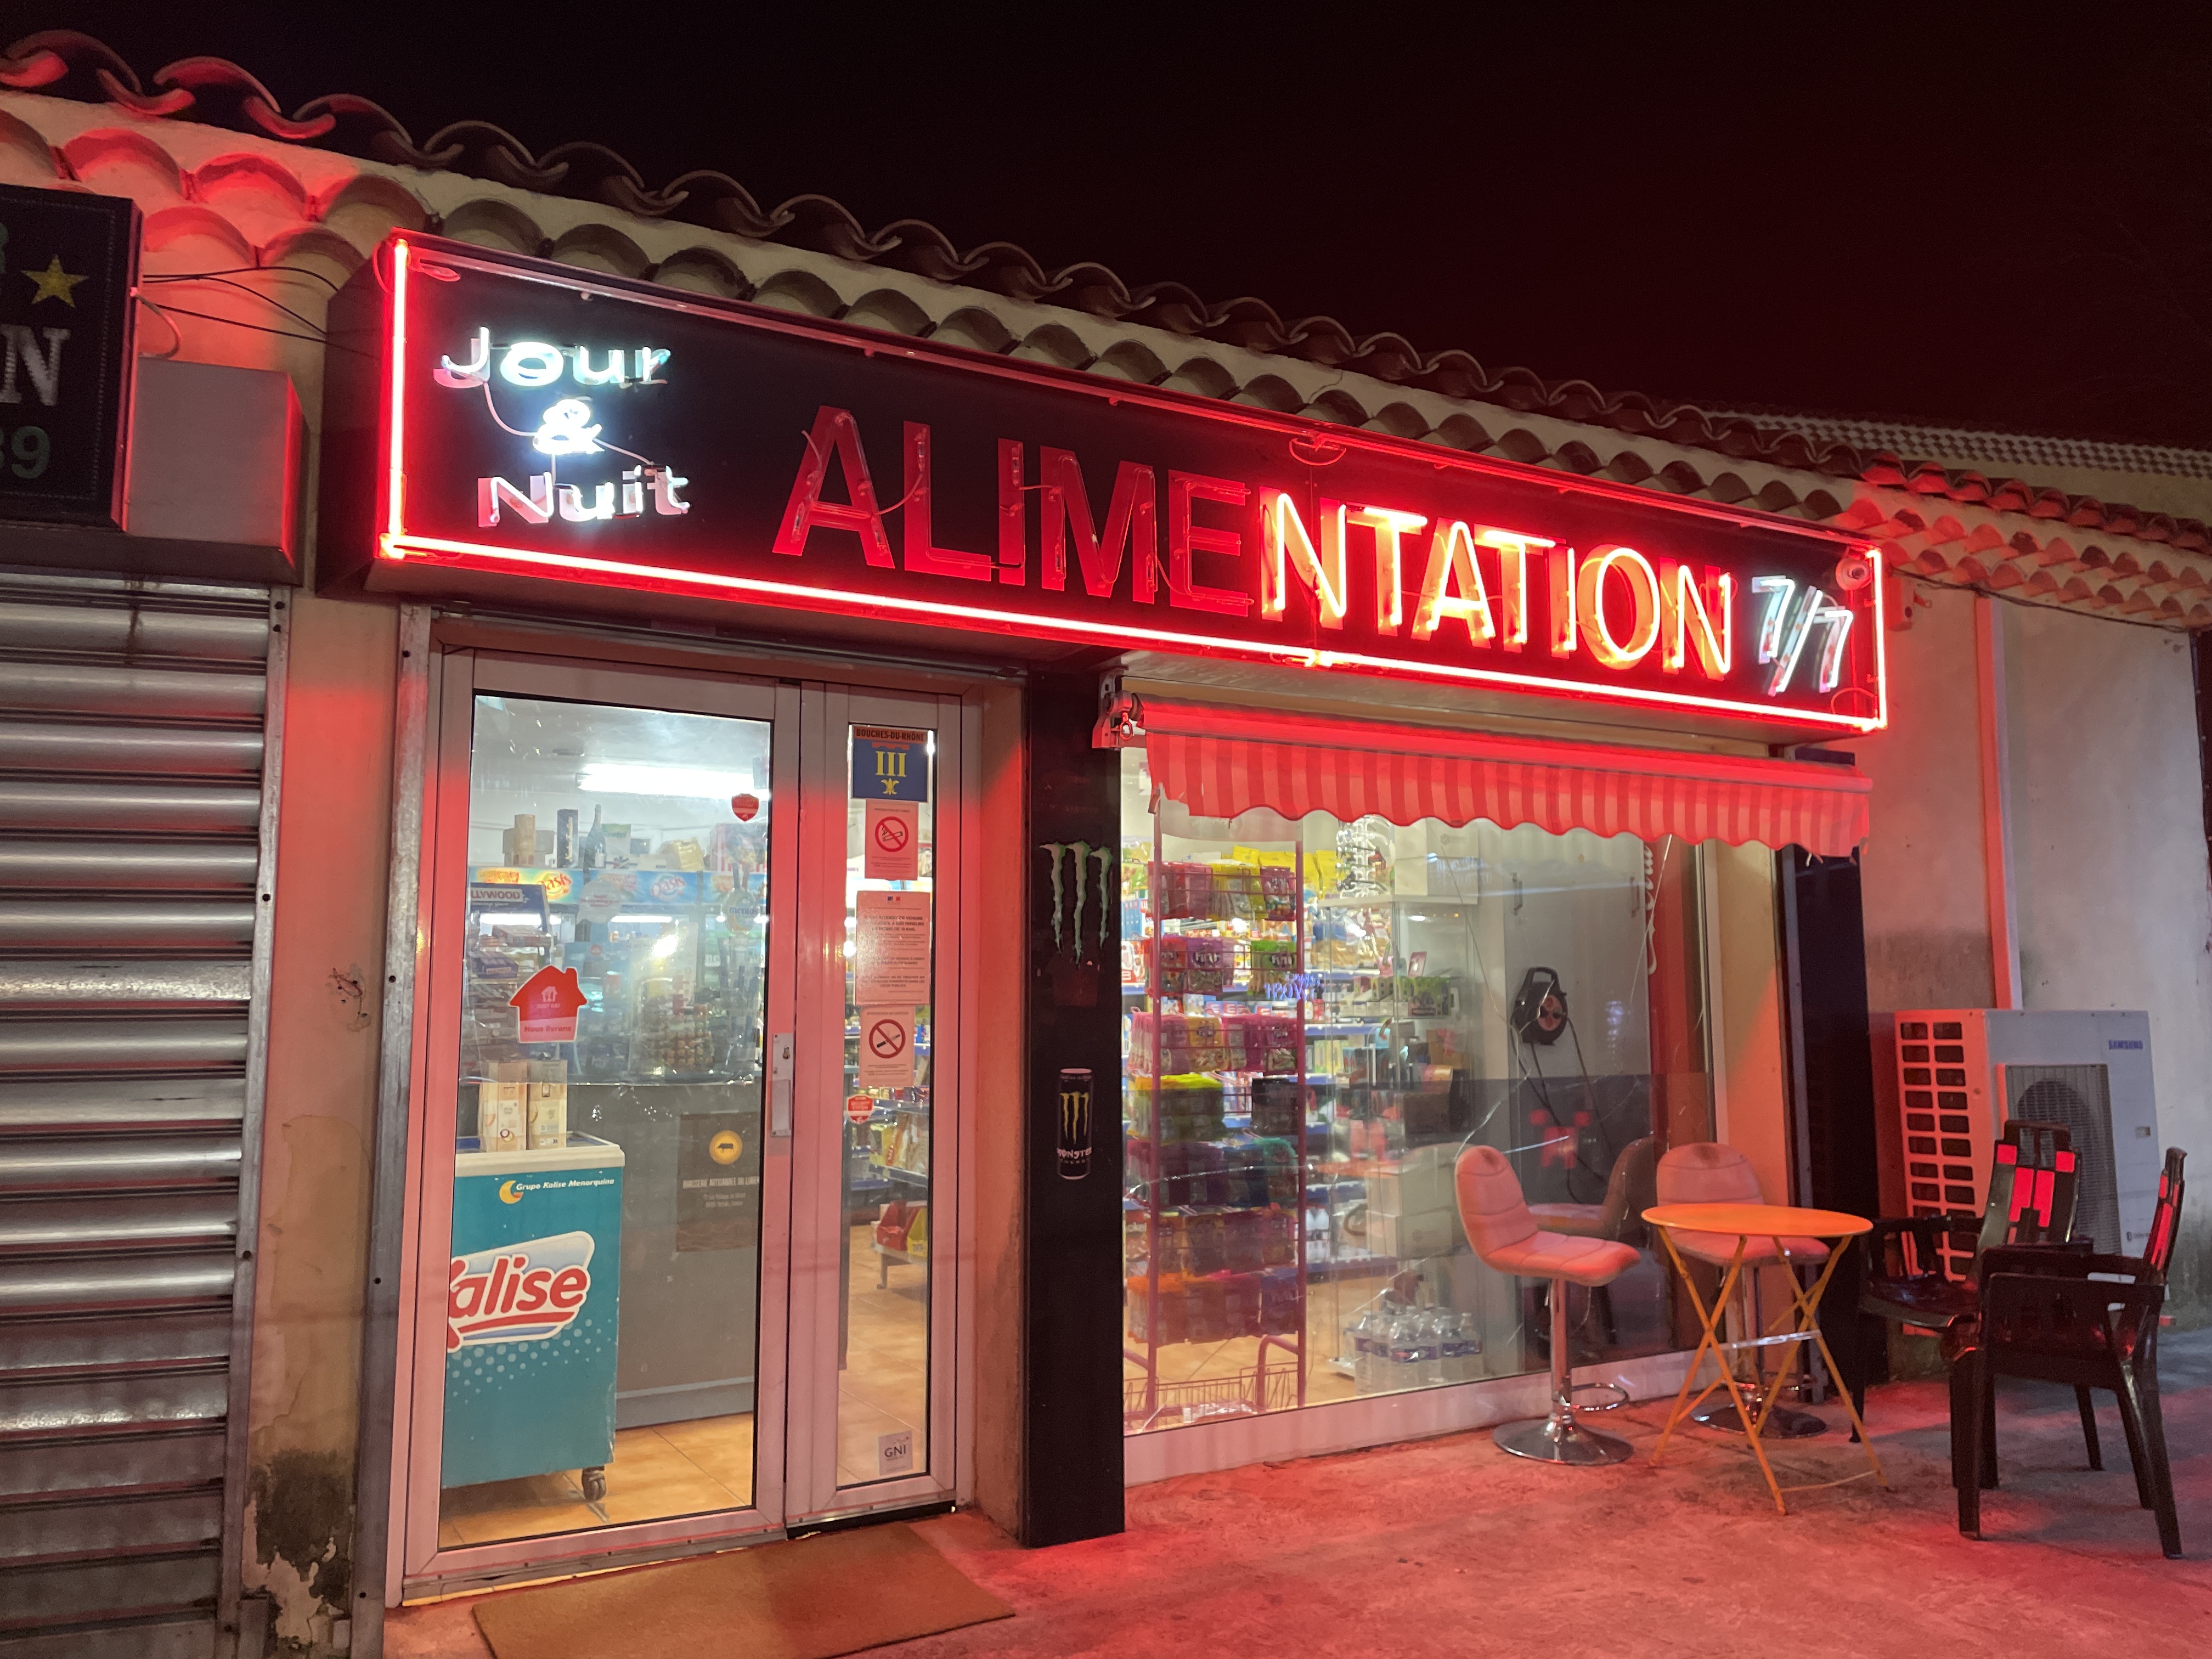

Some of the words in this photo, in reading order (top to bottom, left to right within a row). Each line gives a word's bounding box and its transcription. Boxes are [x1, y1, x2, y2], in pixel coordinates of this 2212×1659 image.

[433, 327, 670, 388] Jour
[533, 397, 604, 455] &
[478, 464, 690, 527] Nuit
[772, 404, 1731, 681] ALIMENTATION
[1752, 575, 1854, 697] 7/7
[856, 728, 924, 742] BOUCHES-DU-RHÔNE
[537, 873, 572, 890] asis
[543, 1181, 567, 1189] Kalise
[568, 1178, 615, 1187] Menorquina
[884, 1444, 906, 1458] GNI
